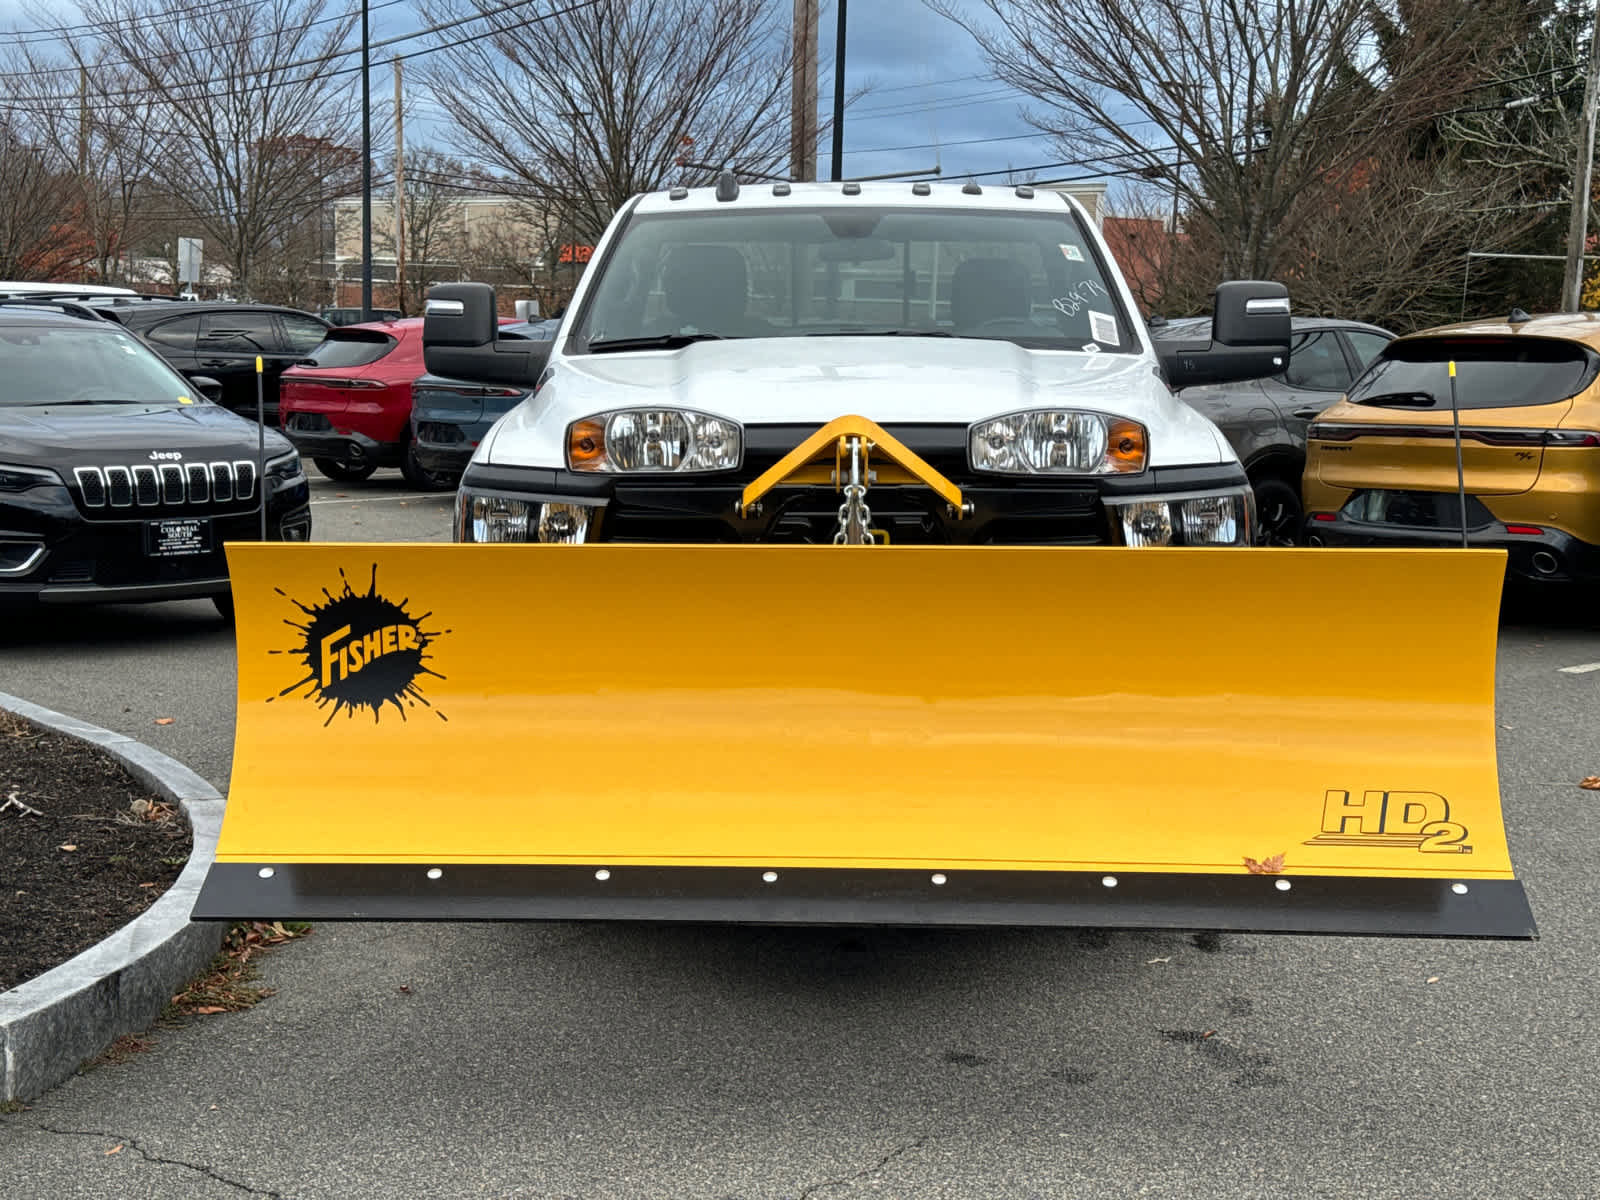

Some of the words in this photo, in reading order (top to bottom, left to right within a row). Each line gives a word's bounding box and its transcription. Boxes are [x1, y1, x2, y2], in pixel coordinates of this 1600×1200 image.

[148, 451, 182, 461] Jeep
[320, 624, 422, 689] FISHER
[1321, 789, 1469, 853] HD2
